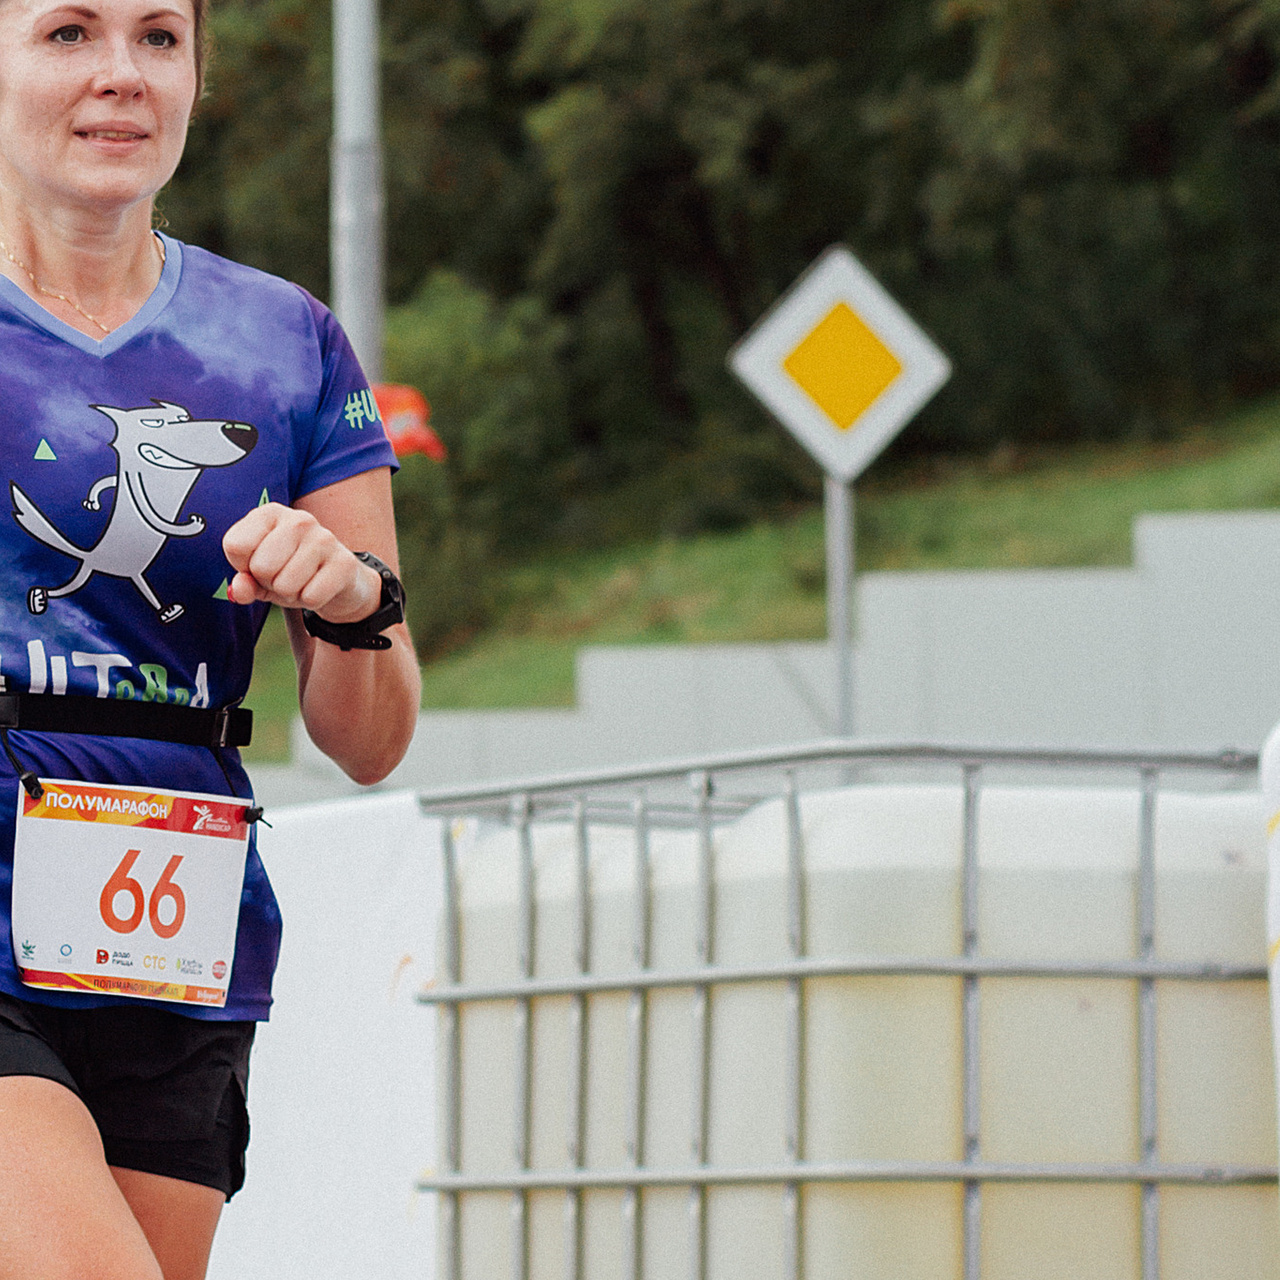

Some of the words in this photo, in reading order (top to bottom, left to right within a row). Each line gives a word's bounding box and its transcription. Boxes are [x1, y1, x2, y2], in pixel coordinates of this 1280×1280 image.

[344, 387, 382, 430] #U
[45, 791, 168, 819] ПОЛУМАРАФОН
[99, 848, 186, 939] 66
